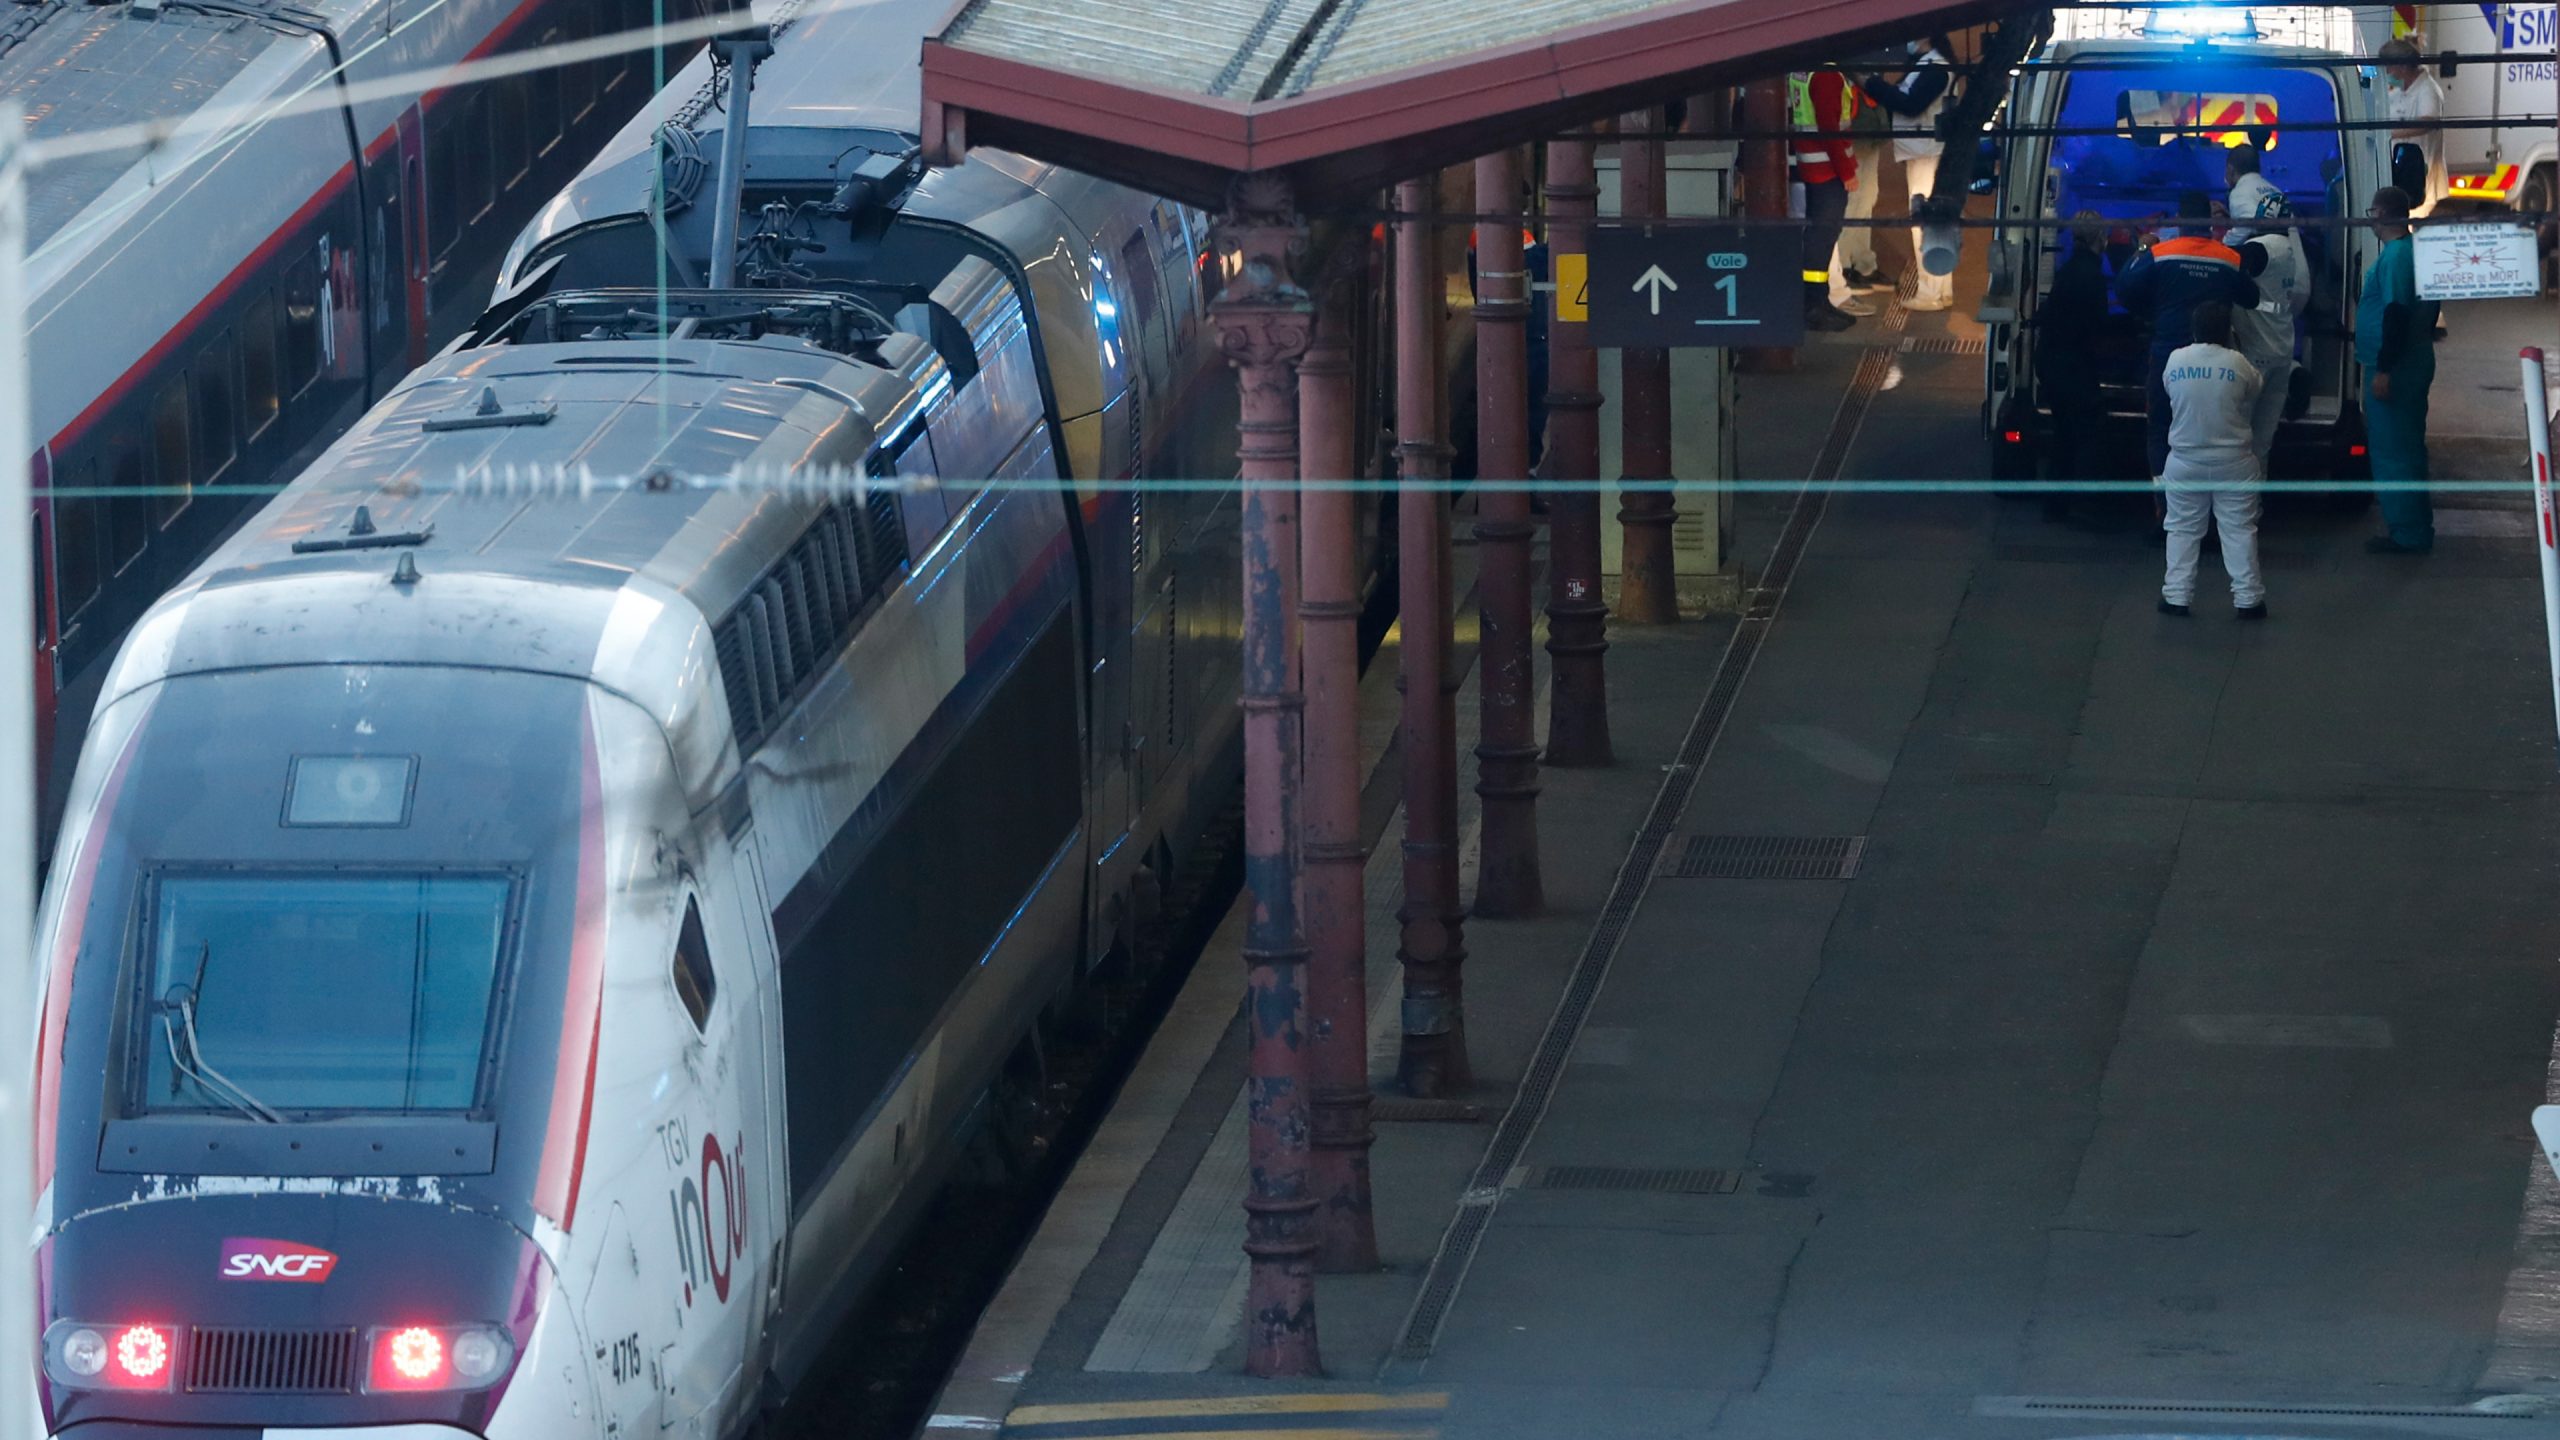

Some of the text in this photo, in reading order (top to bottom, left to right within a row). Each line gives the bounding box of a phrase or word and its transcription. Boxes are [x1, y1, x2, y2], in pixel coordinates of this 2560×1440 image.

[1711, 255, 1742, 267] Voie
[2180, 263, 2219, 273] PROTECTION
[2432, 271, 2475, 285] DANGER
[2489, 269, 2520, 282] MORT
[1714, 274, 1737, 317] 1
[2169, 366, 2236, 382] SAMU 78
[657, 1114, 690, 1171] TGV
[223, 1253, 330, 1277] SNCF
[612, 1331, 641, 1386] 4715
